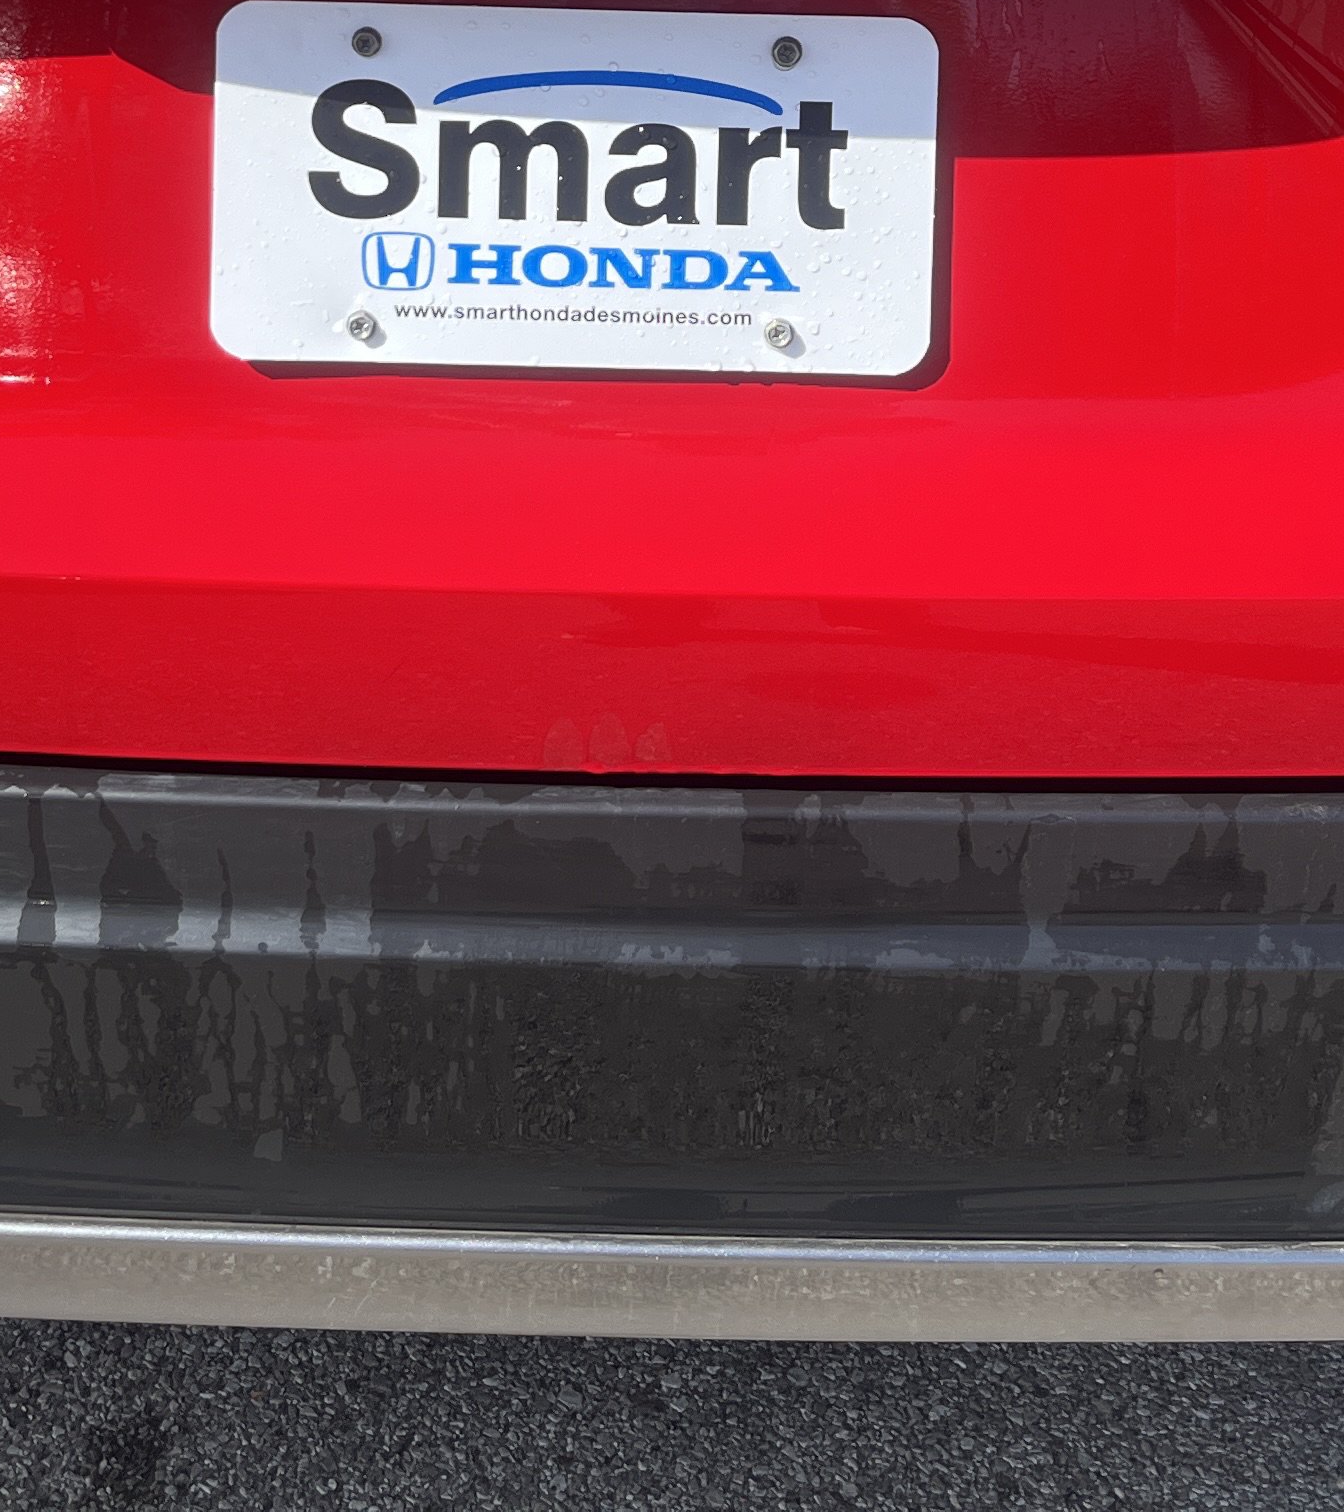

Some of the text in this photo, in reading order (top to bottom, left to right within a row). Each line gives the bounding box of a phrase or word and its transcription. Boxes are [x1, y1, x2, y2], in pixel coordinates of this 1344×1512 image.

[307, 78, 849, 230] Smart
[447, 243, 801, 293] HONDA
[393, 303, 753, 328] www.smarthondadesmoines.com
